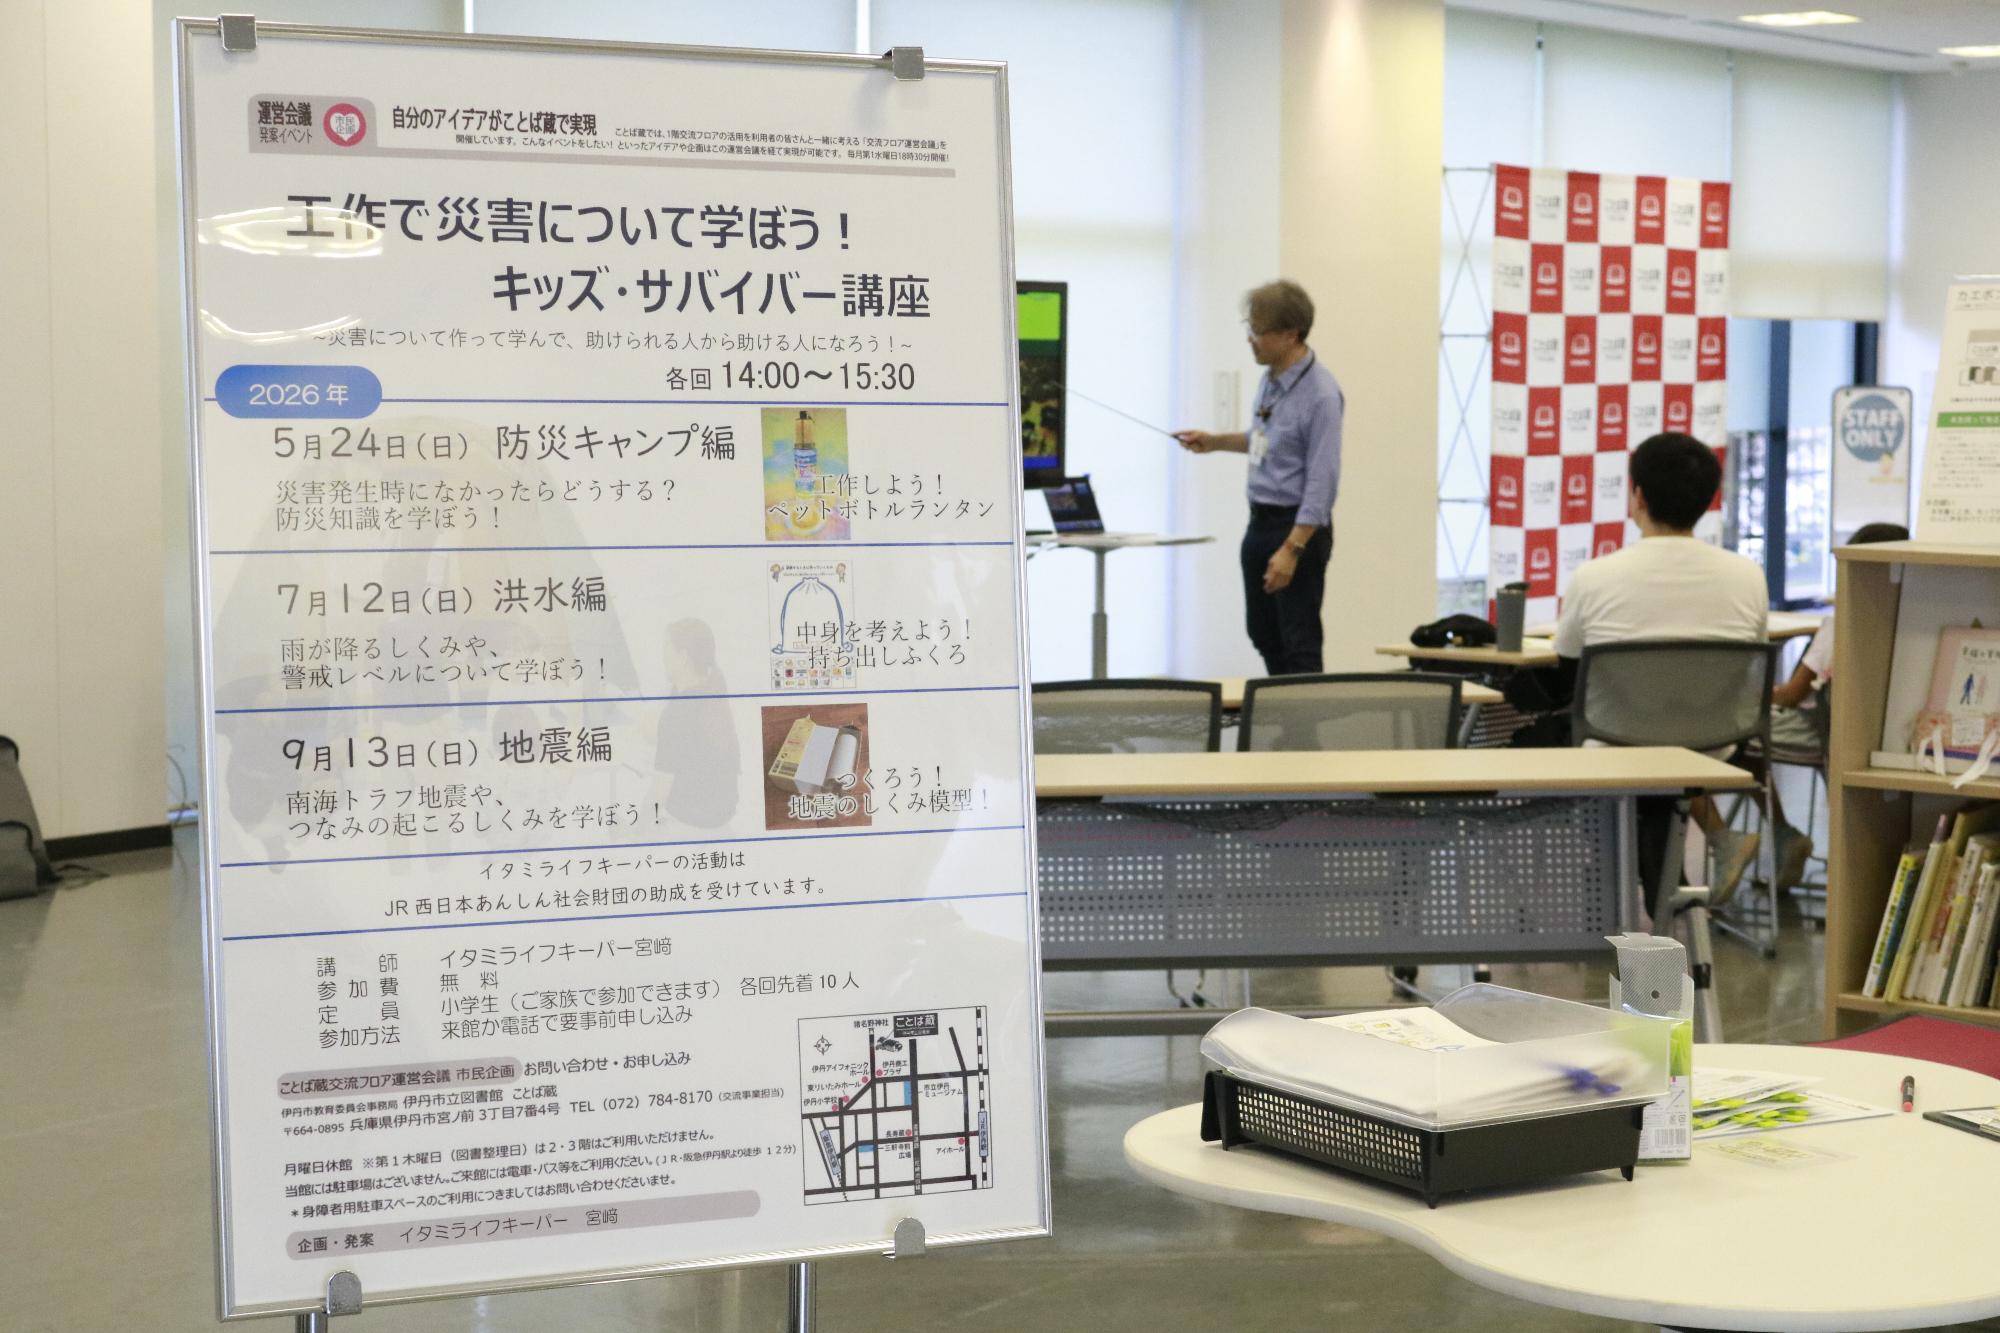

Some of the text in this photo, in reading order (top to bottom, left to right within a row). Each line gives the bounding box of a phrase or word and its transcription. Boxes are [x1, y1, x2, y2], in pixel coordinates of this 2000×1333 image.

[258, 101, 312, 126] 運営会議
[335, 115, 355, 126] 市民
[392, 106, 597, 136] 自分のアイデアがことば蔵で実現
[259, 127, 313, 144] 発案イベント
[286, 193, 850, 251] 工作で災害について学ぼう！
[493, 265, 931, 318] キッズ・サバイバー講座
[666, 367, 711, 391] 各回
[249, 383, 349, 407] 2026年
[1844, 408, 1900, 428] STAFF
[273, 423, 735, 462] 5月24日（日） 防災キャンプ編
[1845, 430, 1897, 450] ONLY
[276, 479, 675, 505] 災害発生時になかったらどうする？
[815, 473, 943, 496] 工作しよう！
[276, 505, 500, 532] 防災知識を学ぼう！
[768, 498, 994, 521] ペットボトルランタン
[494, 576, 606, 614] 洪水編
[797, 619, 971, 645] 中身を考えよう！
[280, 635, 499, 663] 雨が降るしくみや、
[808, 644, 966, 669] 持ち出しふくろ
[281, 657, 605, 690] 警戒レベルについて学ぼう！
[499, 726, 612, 765] 地震編
[837, 766, 942, 791] つくろう！
[287, 784, 503, 815] 南海トラフ地震や、
[789, 788, 988, 820] 地震のしくみ模型！
[289, 803, 662, 840] つなみの起こるしくみを学ぼう！
[480, 850, 746, 881] イタミライフキーパーの活動は
[441, 979, 721, 1016] 小学生（ご家族で参加できます）
[319, 1004, 693, 1049] 参加方法 来館か電話で要事前申し込み
[280, 1051, 692, 1095] ことば蔵交流フロア運営会議 市民企画 お問い合わせ・お申し込み
[281, 1084, 558, 1118] 伊丹市教育委員会事務局 伊丹市立図書館 ことば蔵
[349, 1109, 475, 1132] 兵庫県伊丹市宮ノ前
[570, 1100, 595, 1114] TEL
[648, 1090, 713, 1107] 784-8170
[284, 1158, 353, 1176] 月曜日休館
[297, 1232, 375, 1254] 企画・発案
[400, 1213, 569, 1244] イタミライフキーパー
